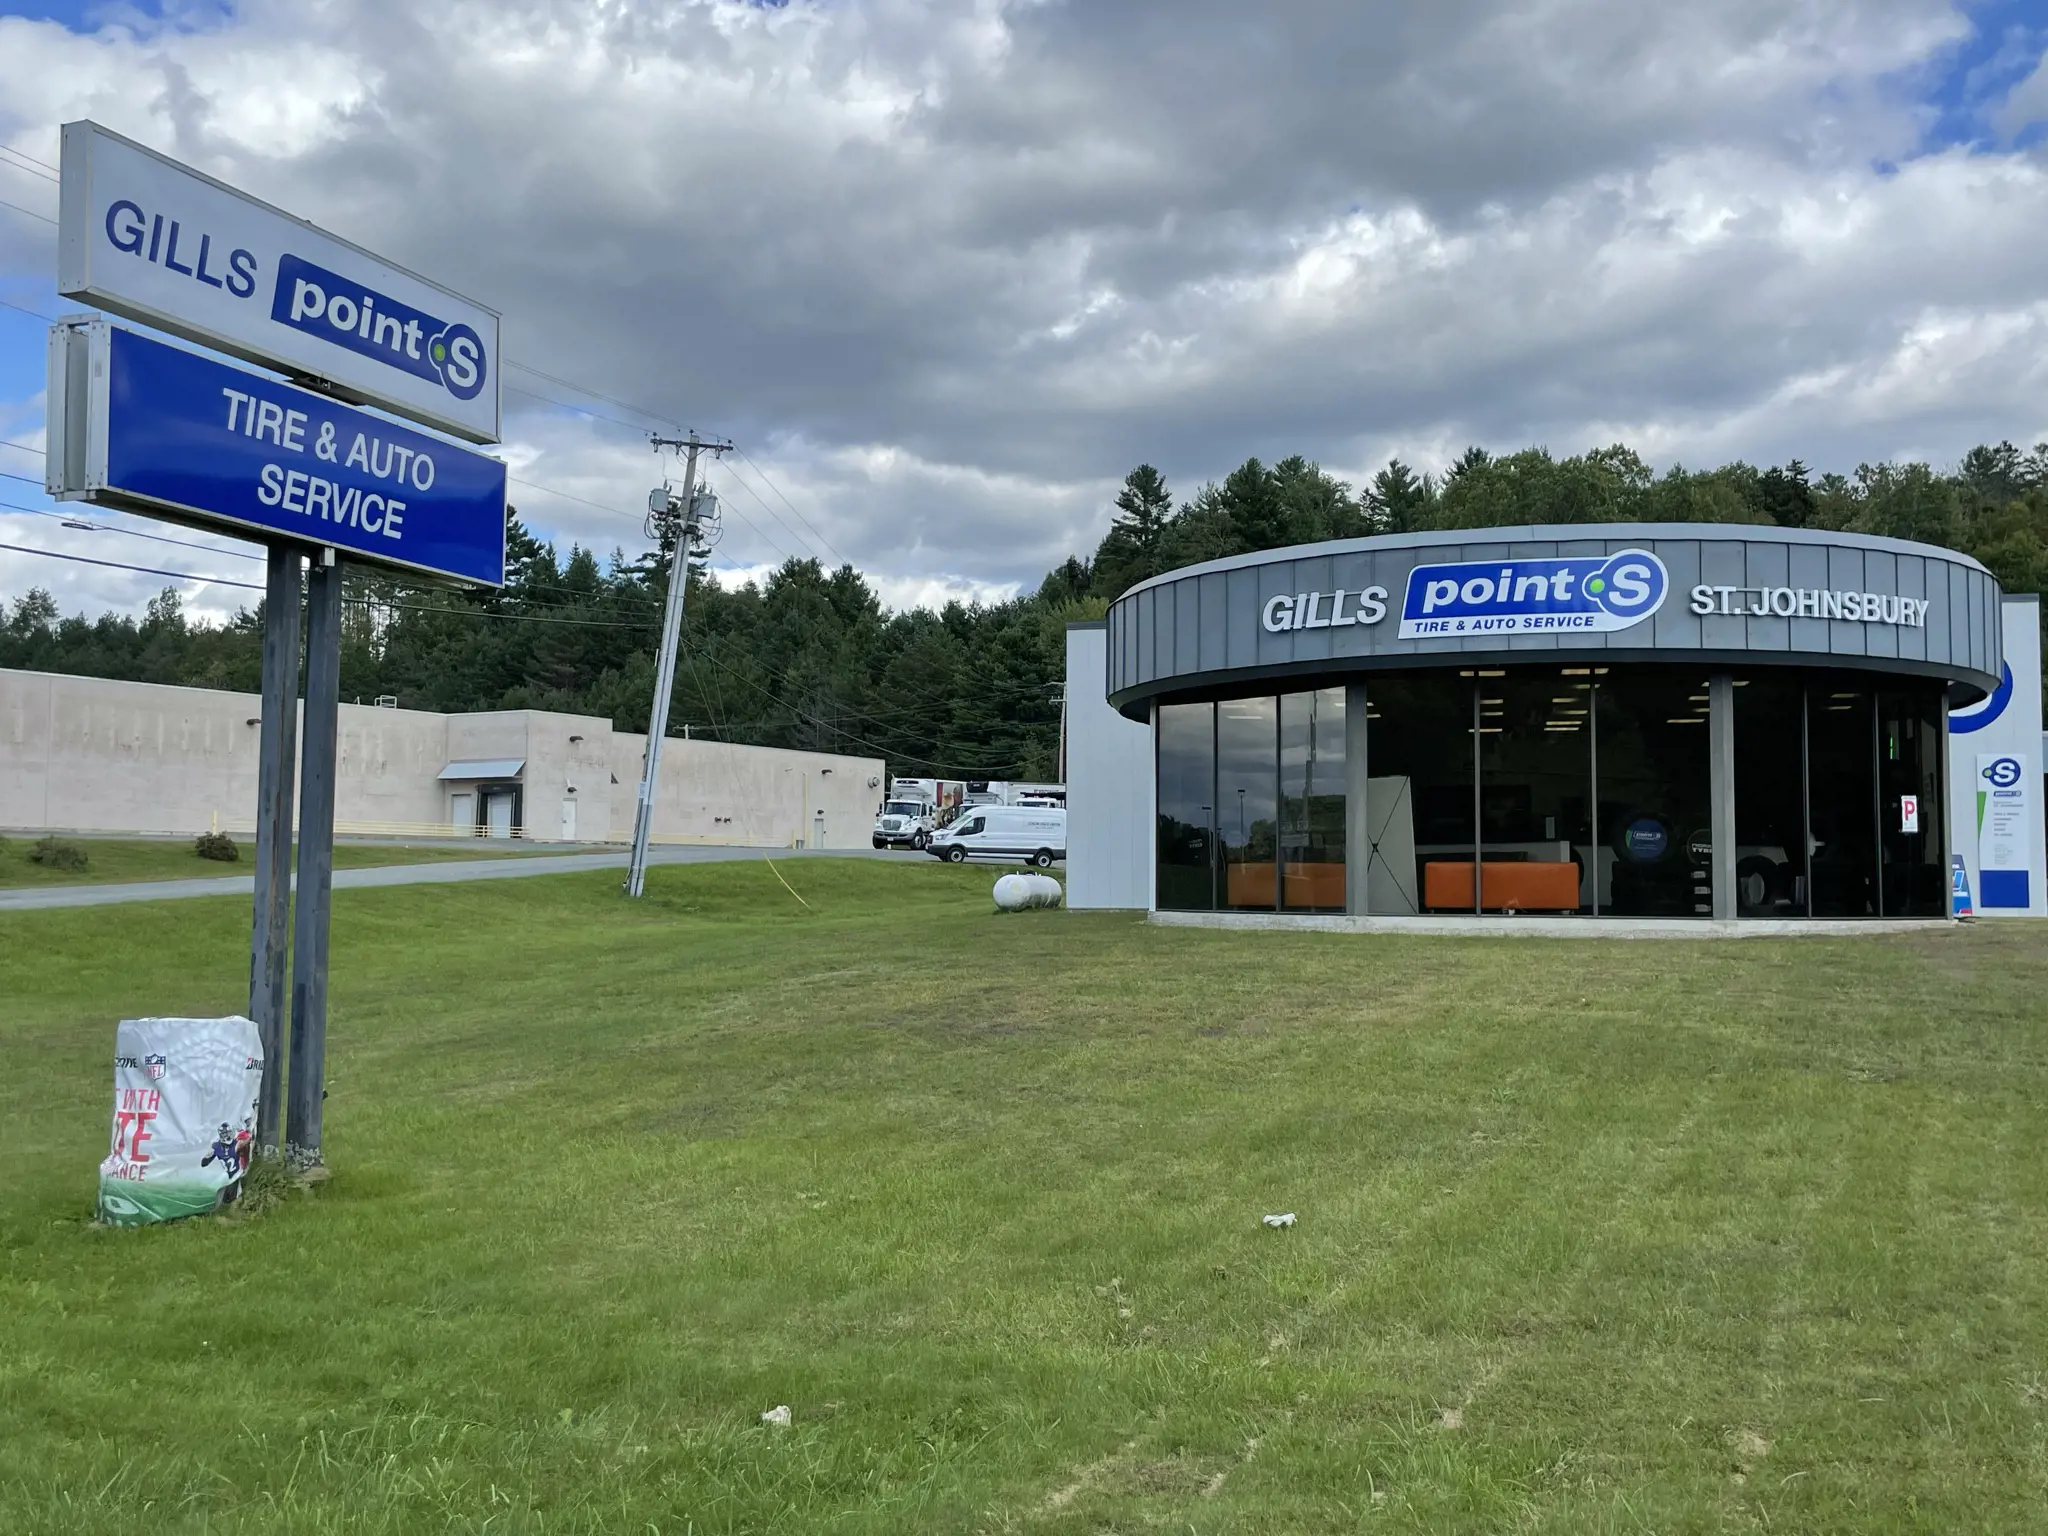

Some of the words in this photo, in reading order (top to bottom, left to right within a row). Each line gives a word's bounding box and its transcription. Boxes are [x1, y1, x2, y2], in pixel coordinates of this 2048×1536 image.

[105, 199, 258, 299] GILLS
[291, 277, 423, 360] point
[222, 387, 308, 453] TIRE
[314, 421, 339, 463] &
[345, 432, 436, 492] AUTO
[257, 463, 407, 540] SERVICE
[1262, 585, 1389, 634] GILLS
[1422, 567, 1573, 614] point
[1690, 584, 1741, 616] ST.
[1751, 586, 1930, 628] JOHNSBURY
[1414, 621, 1453, 633] TIRE
[1456, 620, 1467, 632] &
[1472, 618, 1516, 630] AUTO
[1522, 615, 1595, 629] SERVICE
